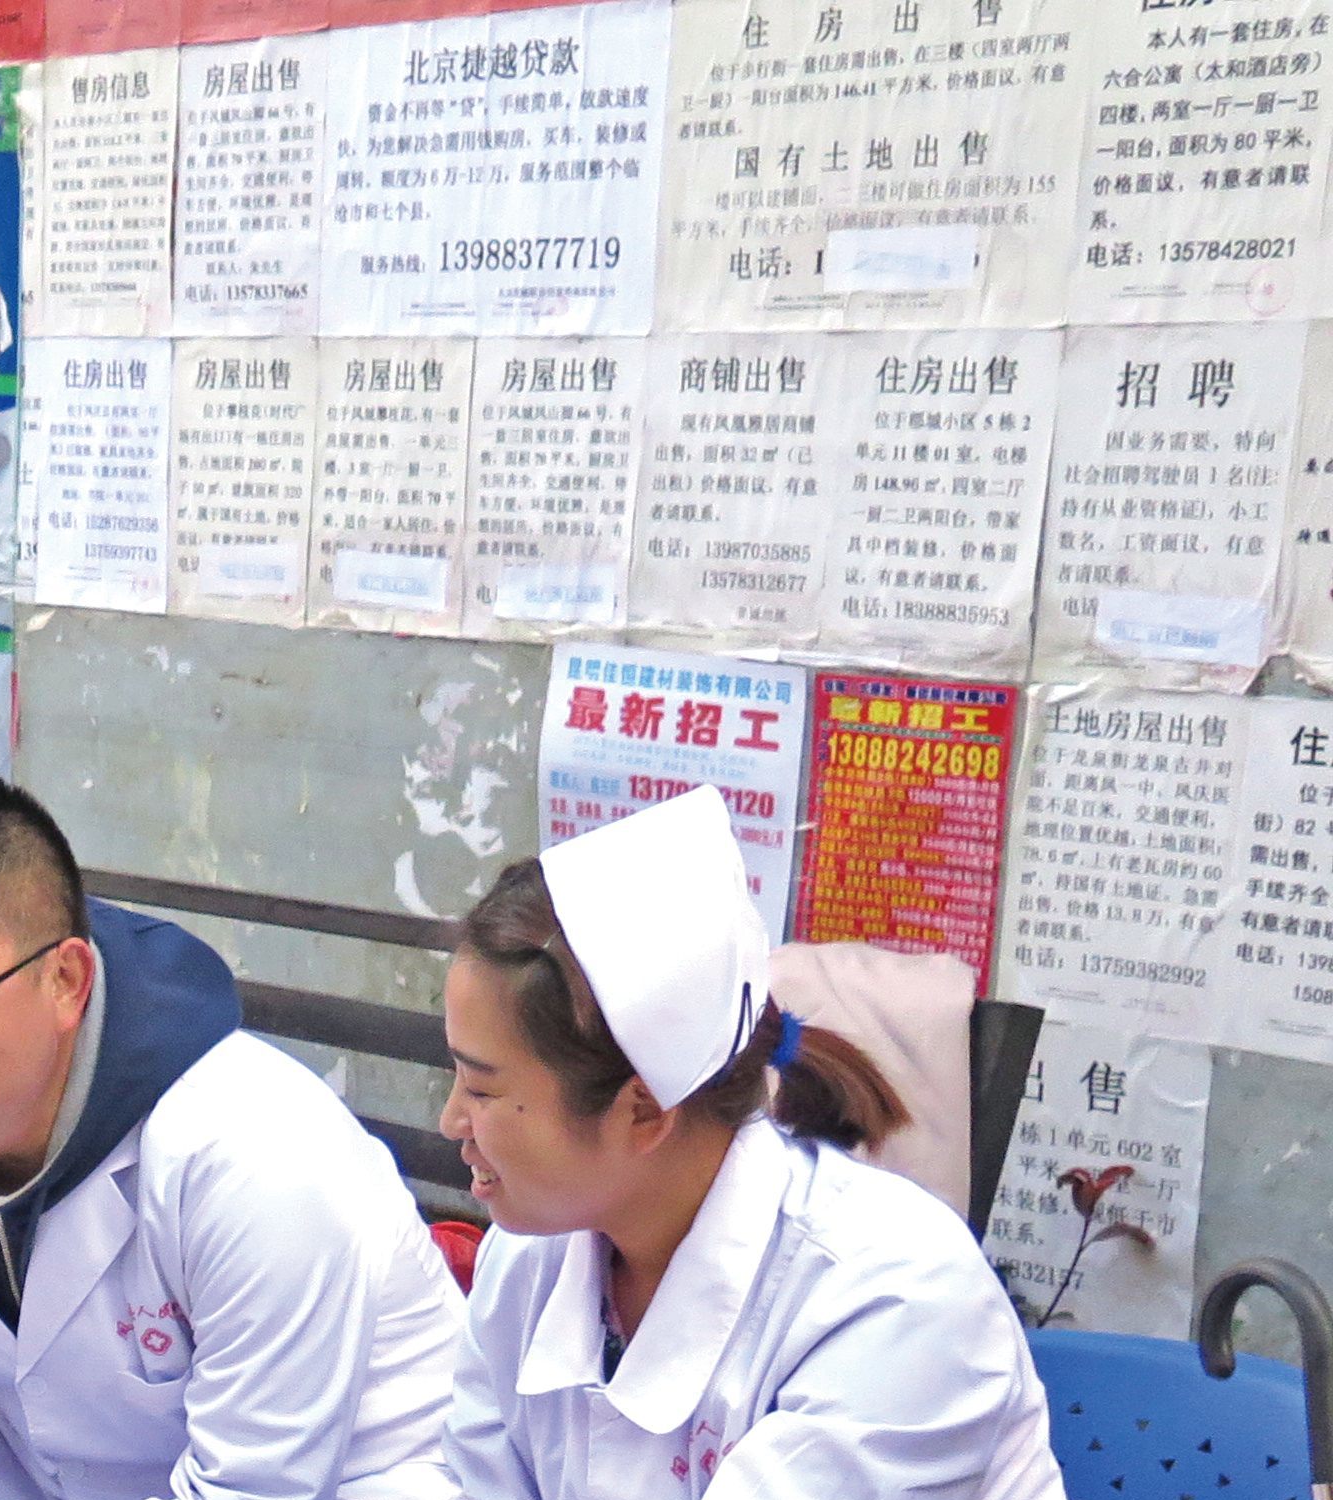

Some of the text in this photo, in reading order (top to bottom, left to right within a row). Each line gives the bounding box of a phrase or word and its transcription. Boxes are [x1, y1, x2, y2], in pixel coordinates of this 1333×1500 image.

[742, 0, 1004, 50] 住房出售
[1146, 13, 1330, 50] 本人有一套住房，在
[204, 58, 300, 98] 房屋出售
[403, 37, 581, 86] 北京捷越贷款
[72, 70, 151, 104] 售房信息
[734, 130, 989, 179] 国有土地出售
[439, 236, 621, 273] 13988377719
[731, 245, 794, 281] 电话：
[1086, 238, 1296, 268] 电话： 13578428021
[63, 359, 147, 390] 住房出售
[195, 358, 291, 390] 房屋出售
[344, 358, 443, 393] 房屋出售
[501, 357, 618, 393] 房屋出售
[680, 356, 806, 393] 商铺出售
[875, 355, 1018, 396] 住房出售
[1116, 358, 1236, 409] 招聘
[647, 536, 691, 559] 电话：
[841, 595, 888, 619] 电话：
[565, 686, 780, 753] 最新招工
[830, 696, 989, 732] 最新招工
[1047, 705, 1229, 747] 土地房屋出售
[828, 732, 1000, 780] 13888242698
[1290, 725, 1333, 766] 住
[1254, 811, 1333, 837] 街）82
[1250, 844, 1333, 873] 需出售，
[1015, 946, 1207, 988] 电话： 13759382992
[1236, 942, 1283, 966] 电话：
